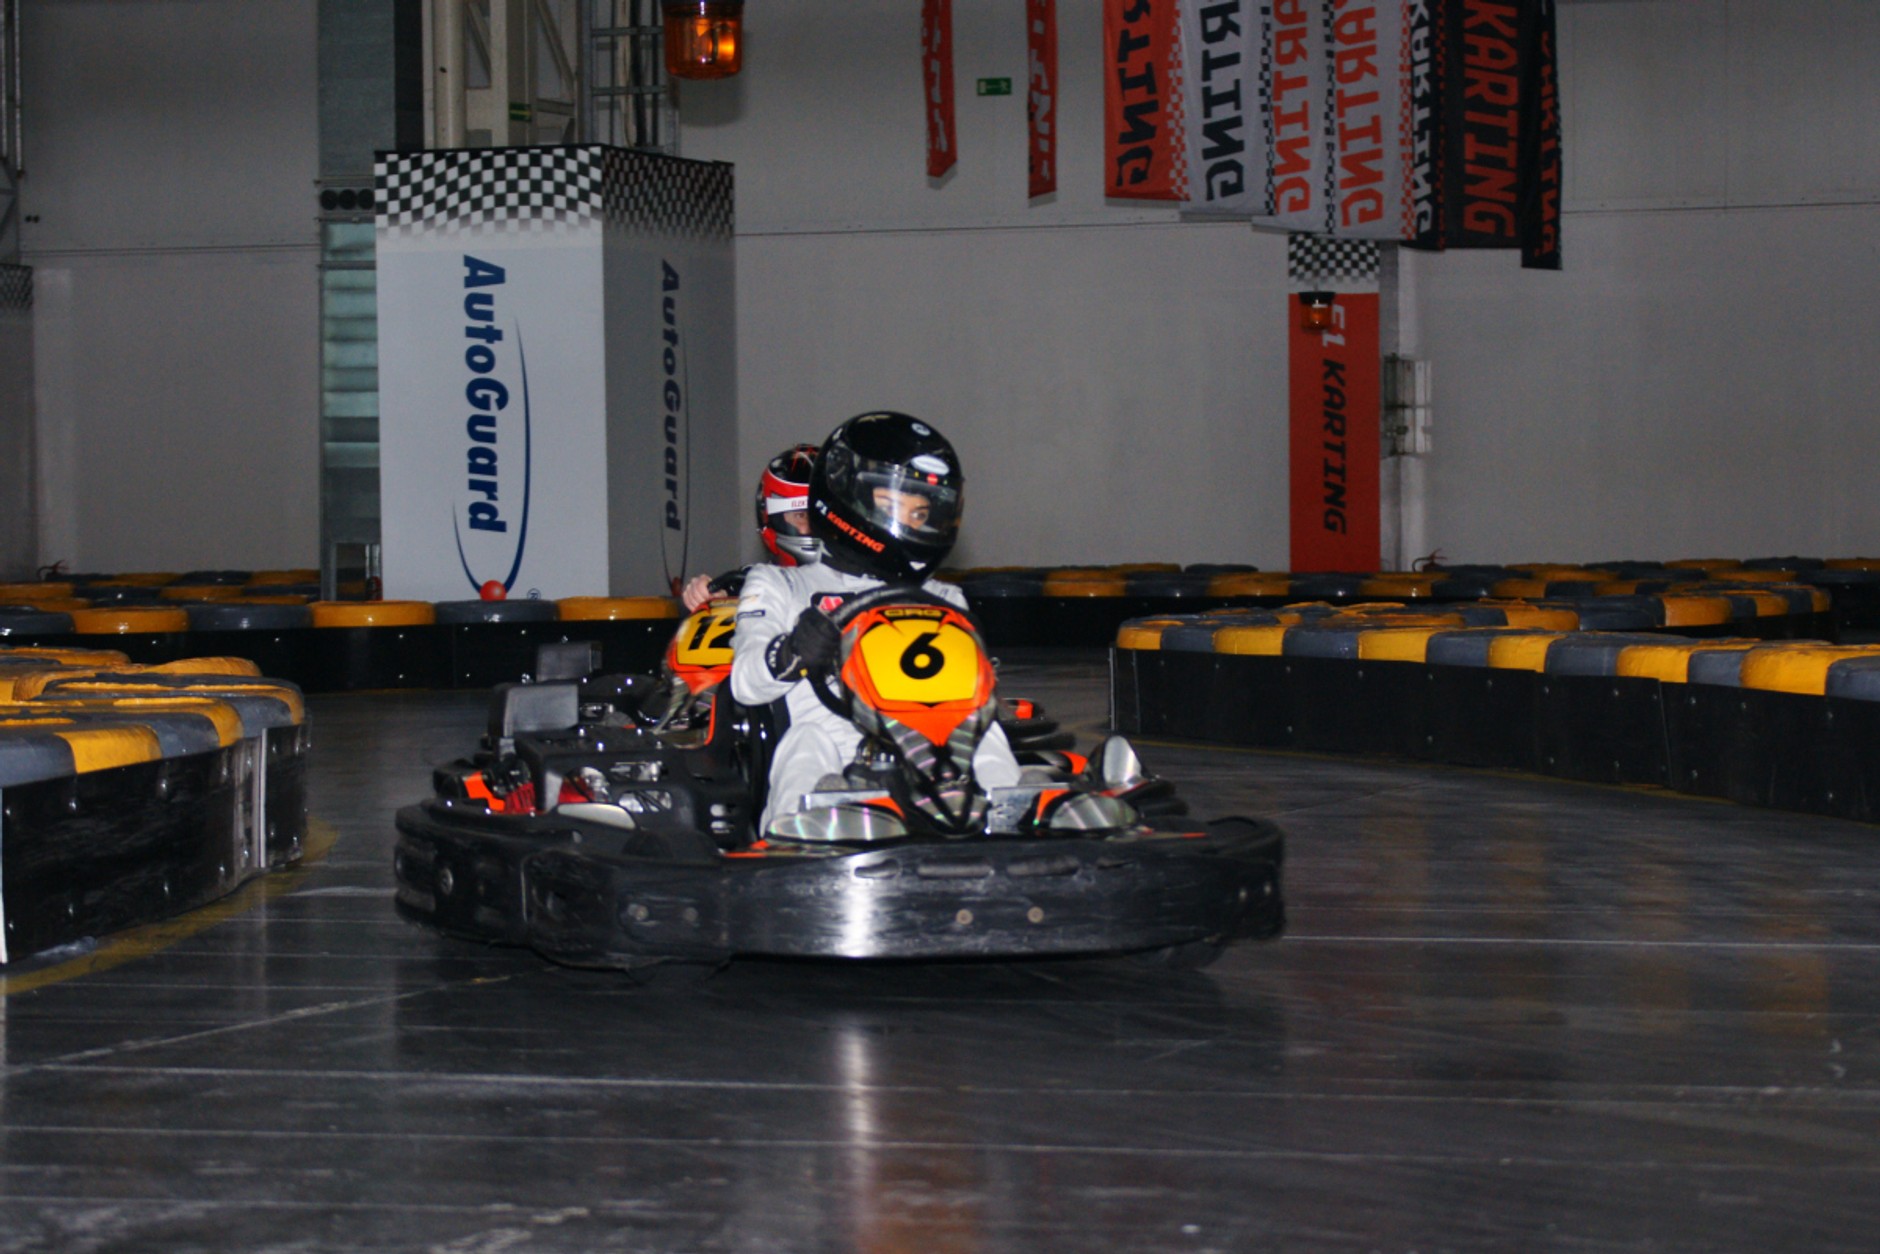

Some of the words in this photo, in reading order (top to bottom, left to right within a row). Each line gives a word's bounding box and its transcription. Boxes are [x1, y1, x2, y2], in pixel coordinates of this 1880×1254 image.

[1462, 0, 1518, 237] KARTING
[463, 254, 509, 532] AutoGuard
[662, 258, 681, 531] AutoGuard
[1322, 358, 1346, 534] KARTING
[826, 511, 885, 553] KARTING
[688, 615, 736, 650] 12
[900, 633, 944, 680] 6
